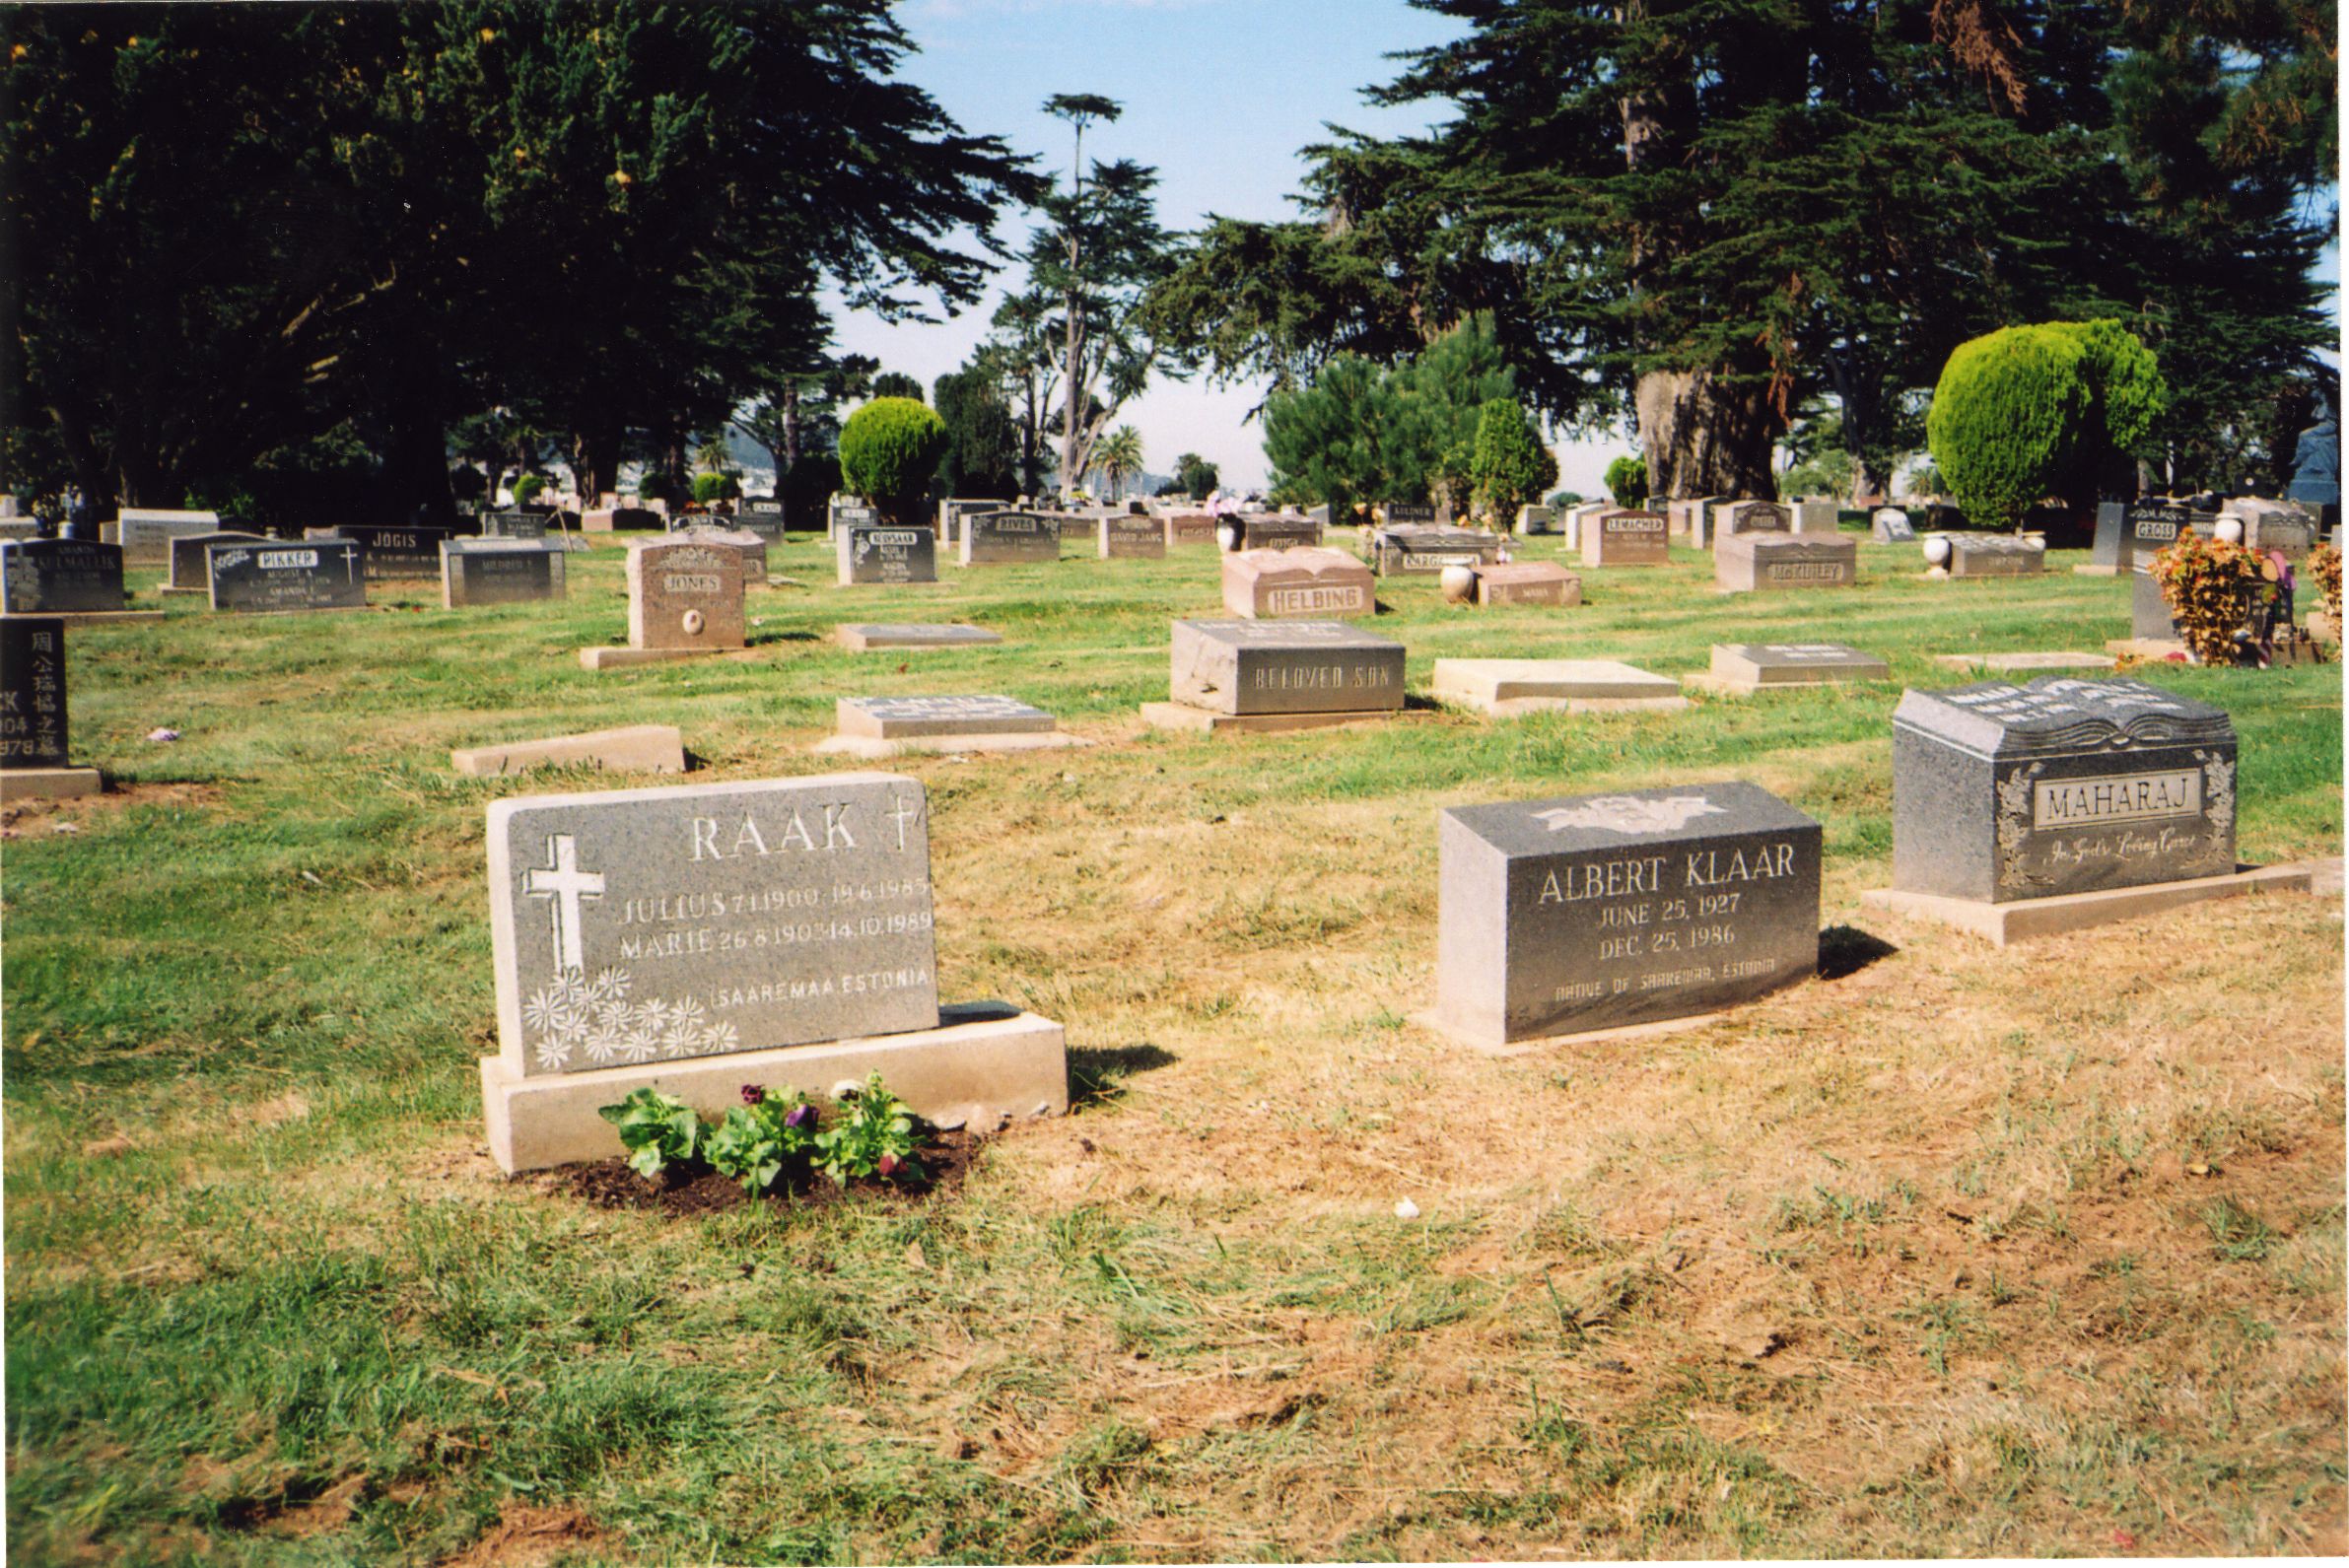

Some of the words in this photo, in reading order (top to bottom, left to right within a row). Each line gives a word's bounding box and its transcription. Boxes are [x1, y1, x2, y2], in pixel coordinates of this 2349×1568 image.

[2137, 522, 2175, 538] GROSS
[263, 550, 312, 566] PIKKER
[670, 577, 719, 589] JONES
[1273, 588, 1358, 612] HELBING
[1255, 666, 1343, 689] BELOVED
[1352, 665, 1390, 688] SON
[2047, 778, 2187, 819] MAHARAJ
[688, 802, 861, 862] RAAK
[1537, 856, 1668, 904] ALBERT
[1684, 844, 1794, 887] KLAAR
[616, 892, 726, 925] JULIUS
[1598, 904, 1650, 930] JUNE
[1698, 893, 1742, 917] 1927
[620, 927, 713, 960] MARIE
[1599, 936, 1644, 961] DEC.
[1690, 924, 1736, 948] 1986
[1613, 977, 1629, 993] OF
